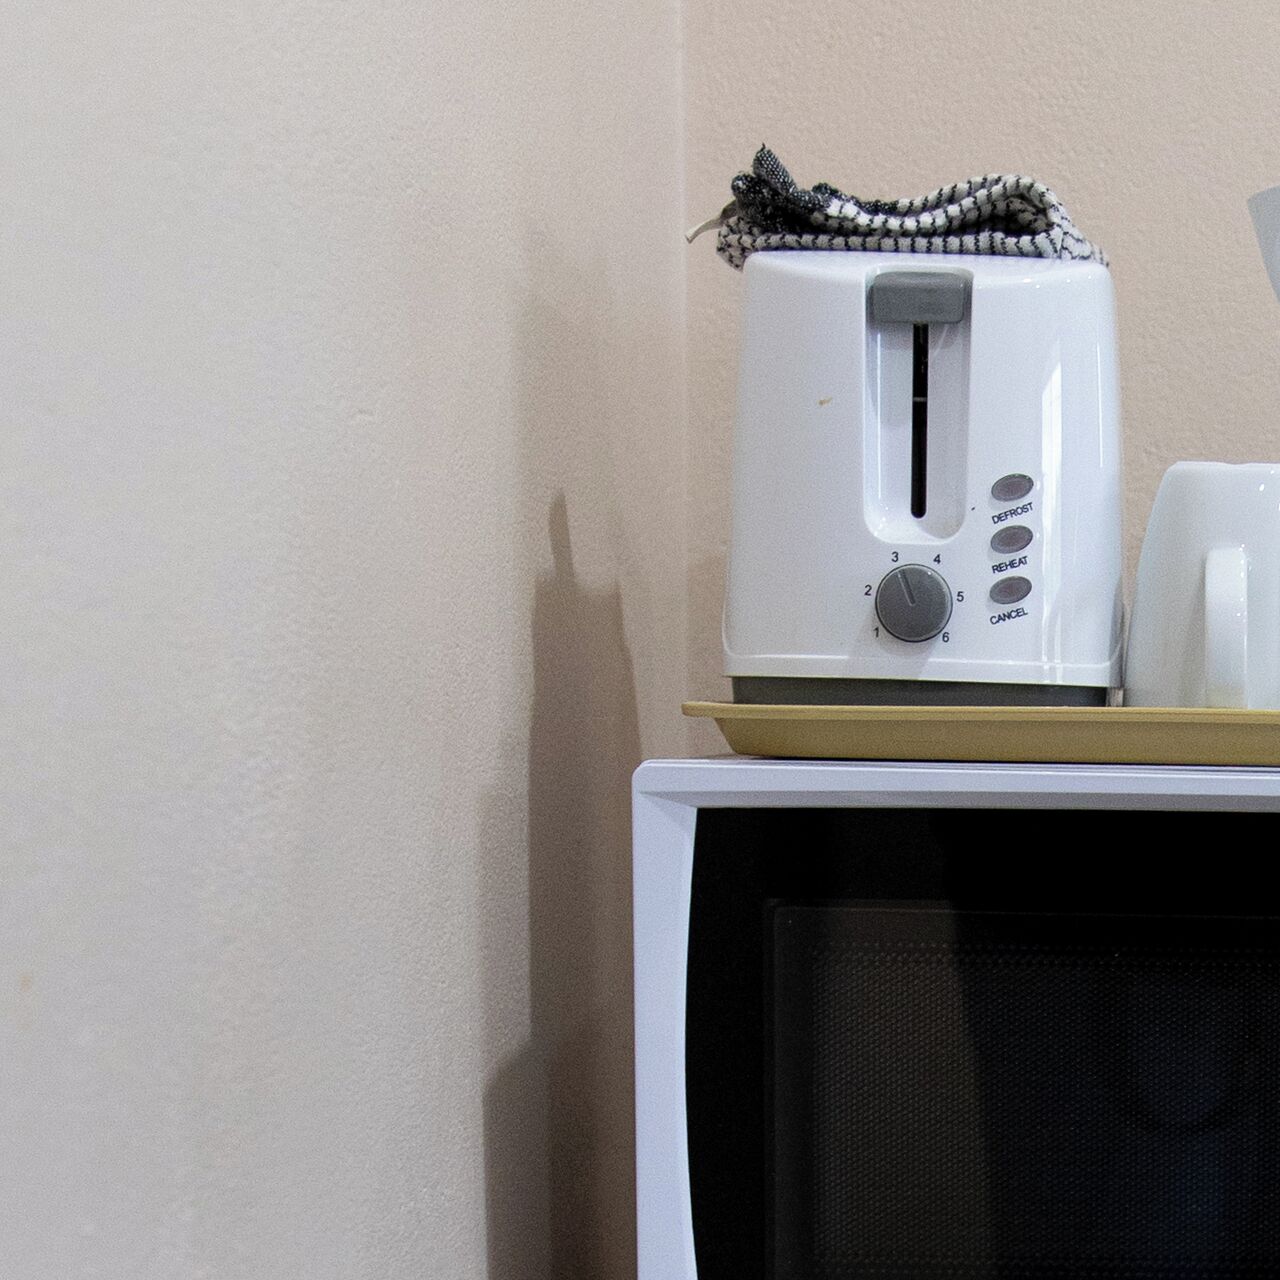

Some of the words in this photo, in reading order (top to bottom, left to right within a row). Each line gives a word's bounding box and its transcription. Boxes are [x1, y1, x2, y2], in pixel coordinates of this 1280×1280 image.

[991, 502, 1034, 524] DEFROST
[891, 551, 899, 563] 3
[933, 554, 942, 565] 4
[991, 556, 1028, 574] REHEAT
[864, 584, 872, 596] 2
[956, 591, 965, 602] 5
[989, 607, 1029, 626] CANCEL
[873, 626, 879, 638] 1
[942, 631, 950, 643] 6
